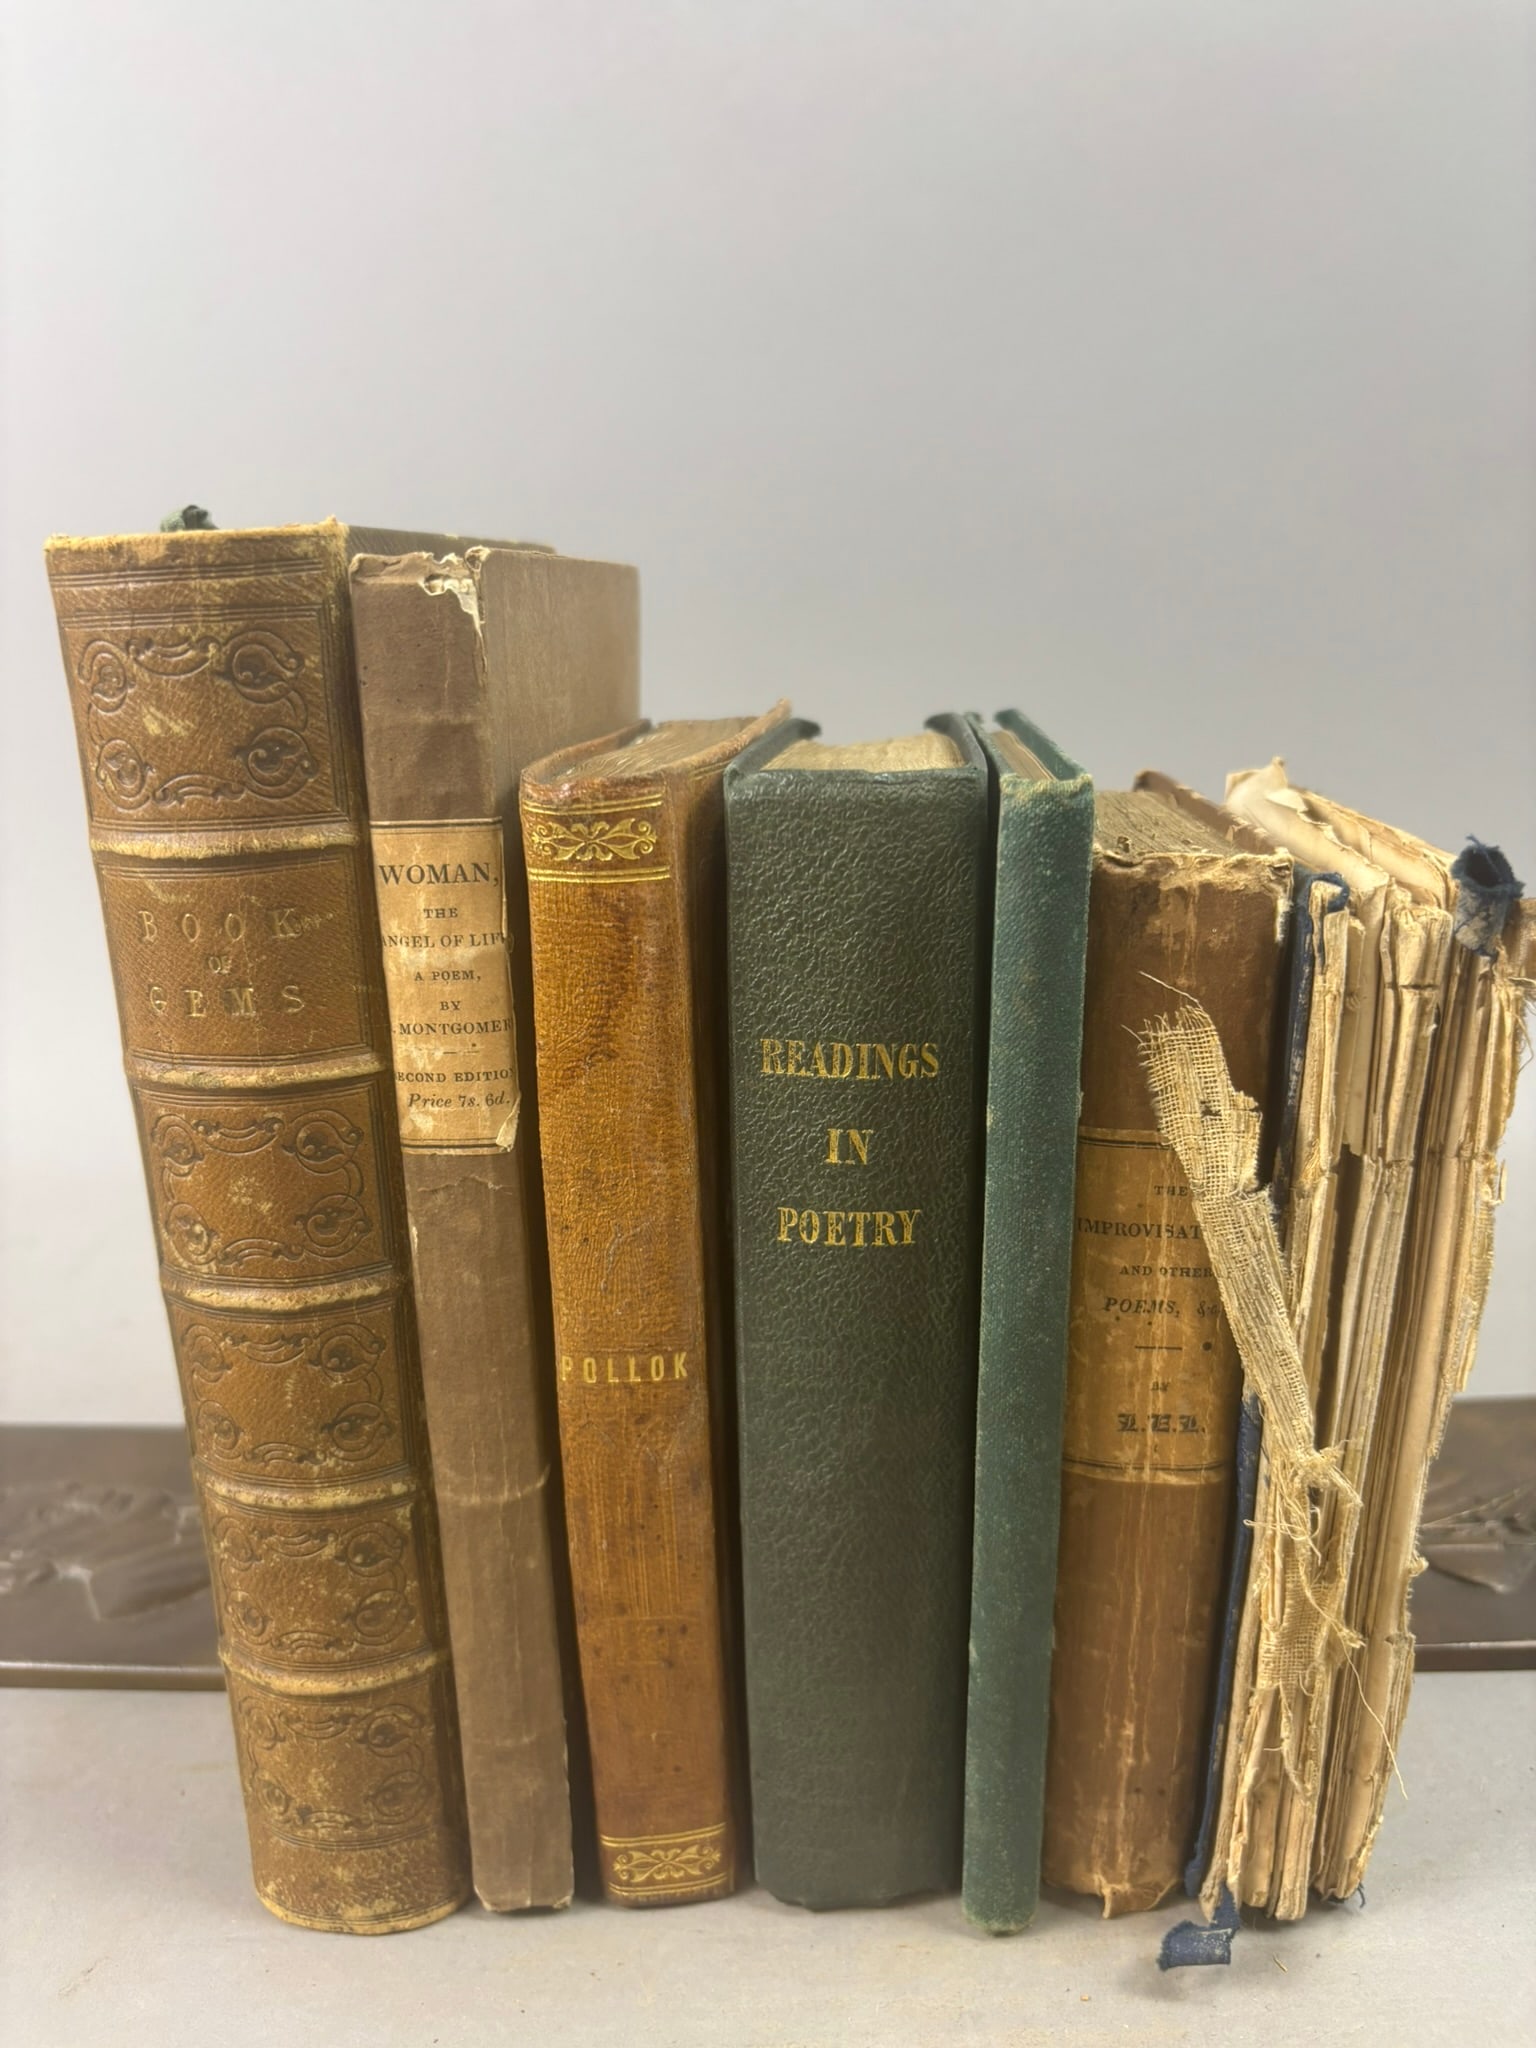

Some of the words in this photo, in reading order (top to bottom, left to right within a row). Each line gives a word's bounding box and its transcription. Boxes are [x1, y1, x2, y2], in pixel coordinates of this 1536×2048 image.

[378, 862, 500, 887] WOMAN,
[423, 907, 459, 920] THE
[138, 907, 302, 943] BOOK
[440, 934, 465, 949] OF
[414, 971, 425, 982] A
[431, 970, 482, 983] POEM,
[150, 985, 305, 1018] GEMS
[439, 1000, 462, 1012] BY
[399, 1017, 514, 1036] MONTGOMER
[759, 1038, 940, 1080] READINGS
[396, 1071, 447, 1084] ECOND
[407, 1092, 452, 1109] Price
[458, 1094, 481, 1108] 7s.
[485, 1090, 511, 1107] 6d.
[823, 1127, 875, 1166] IN
[1153, 1185, 1190, 1198] THE
[776, 1206, 922, 1248] POETRY
[1119, 1265, 1153, 1277] AND
[1103, 1296, 1181, 1319] POEMS,
[560, 1351, 689, 1384] POLLOK
